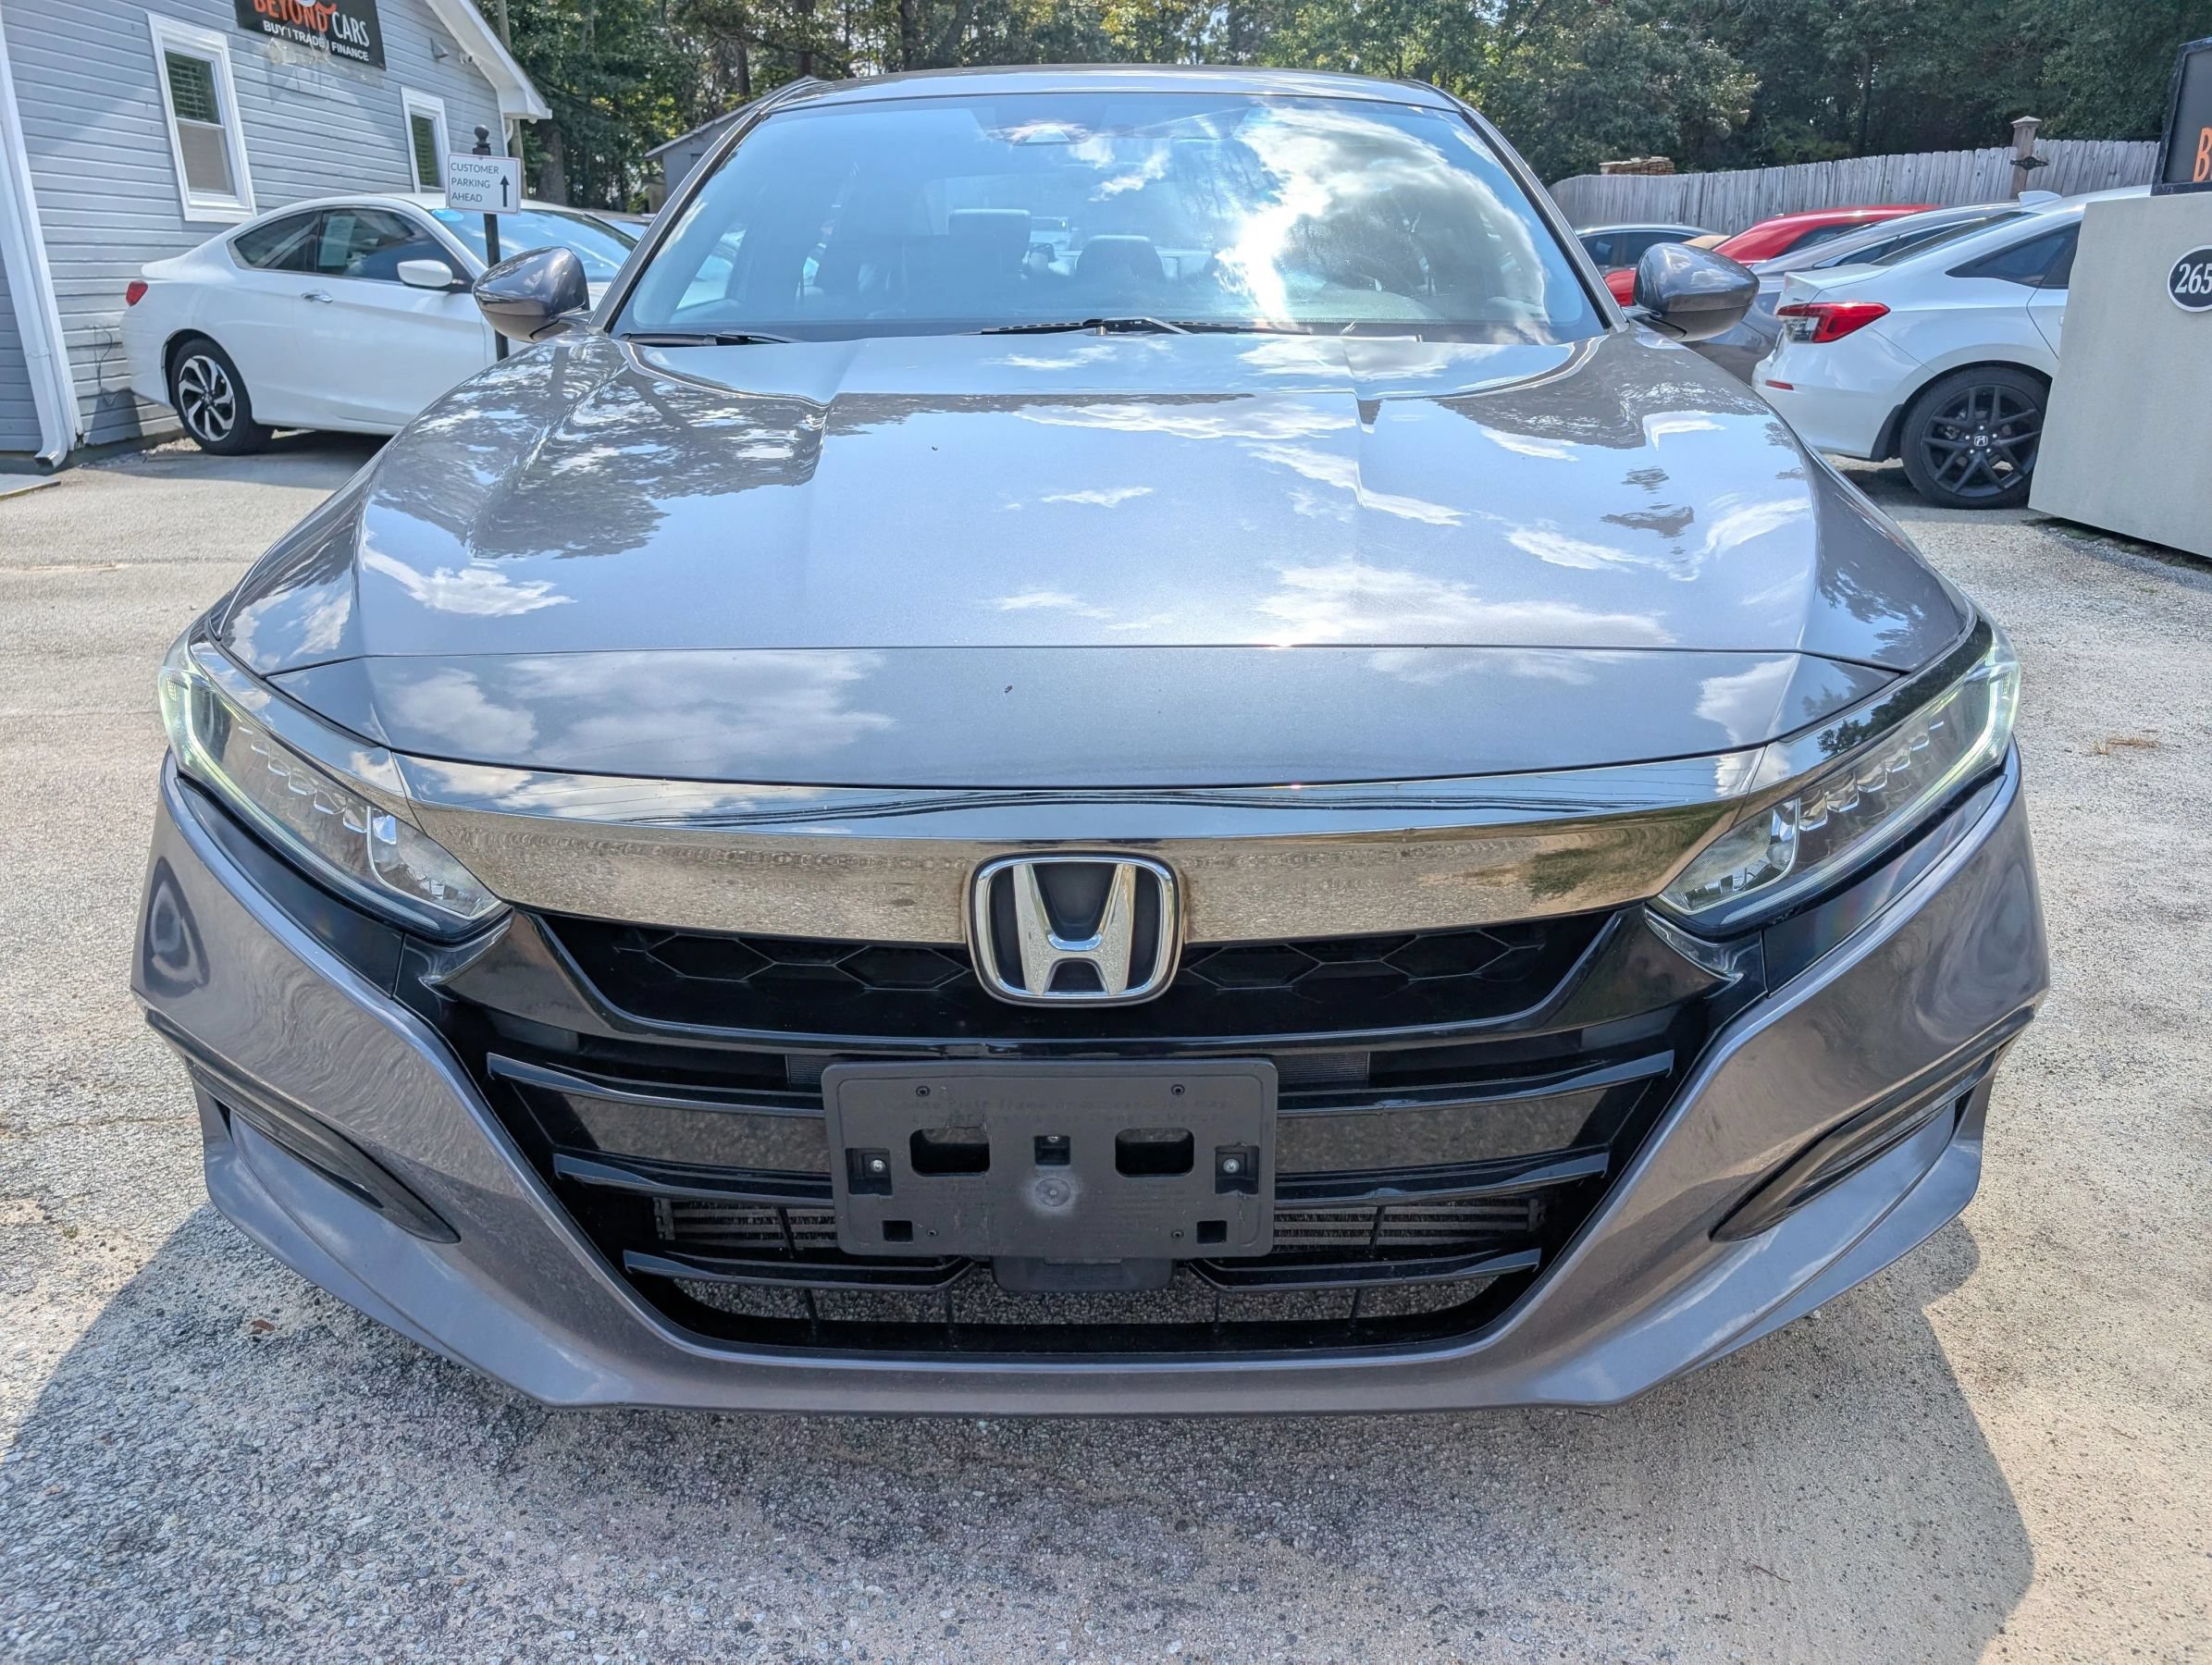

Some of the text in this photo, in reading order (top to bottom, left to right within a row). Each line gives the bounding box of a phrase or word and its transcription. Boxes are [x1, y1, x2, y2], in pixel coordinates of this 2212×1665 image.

[331, 11, 370, 47] CARS
[263, 20, 285, 36] BUY
[292, 29, 325, 47] TRADE
[331, 42, 369, 61] FINANCE
[451, 162, 500, 175] CUSTOMER
[451, 178, 490, 189] PARKING
[451, 191, 483, 203] AHEAD
[2174, 263, 2212, 294] 265
